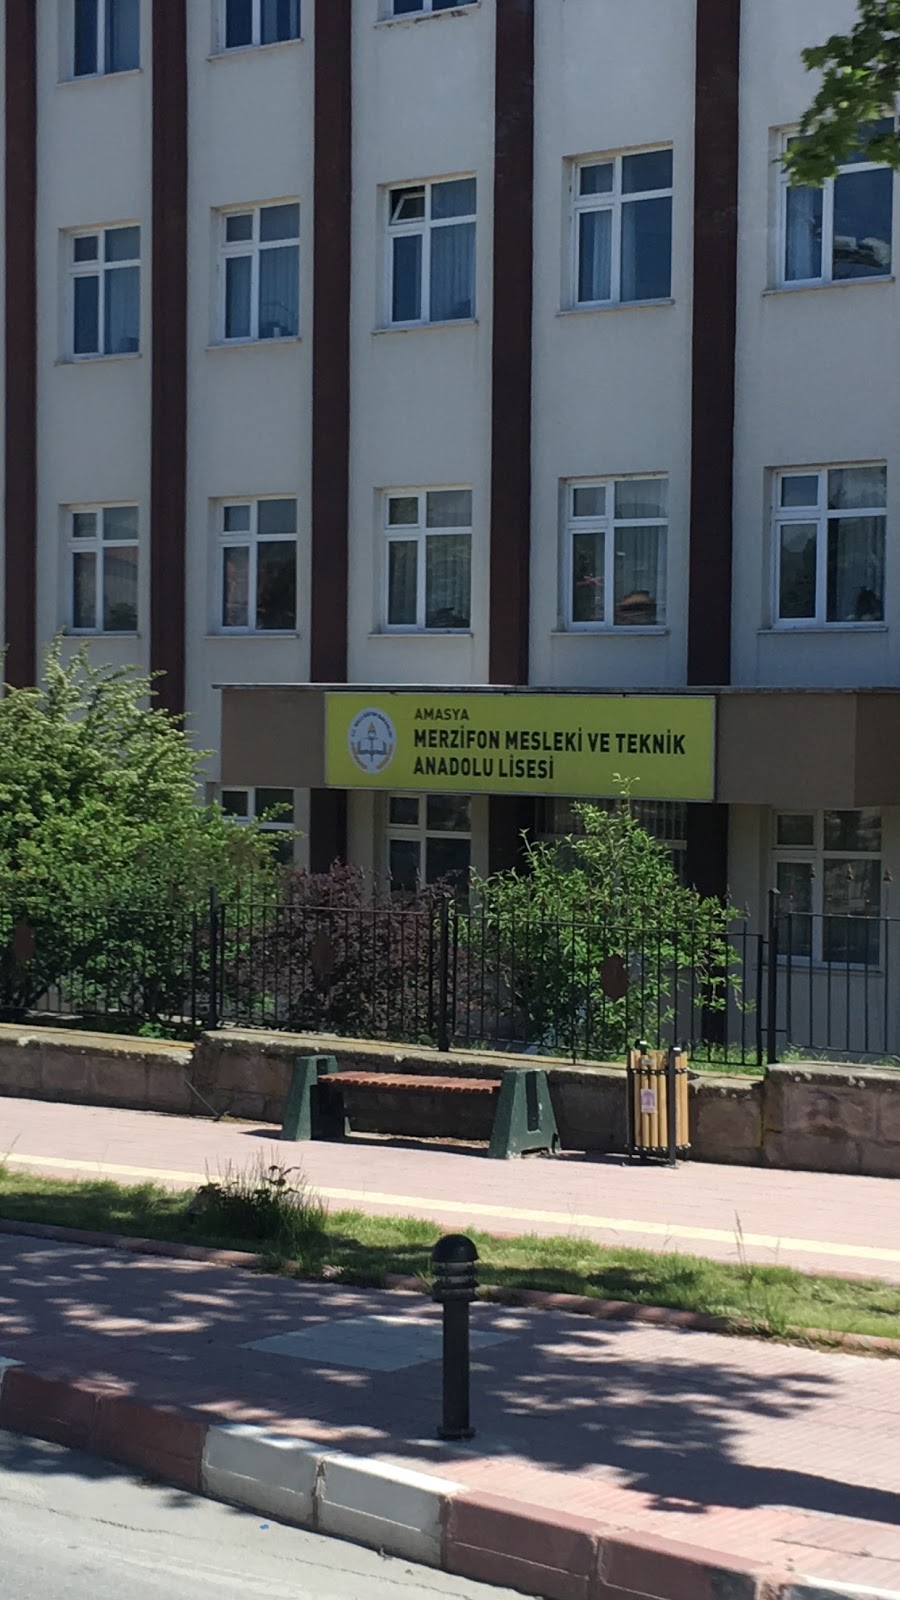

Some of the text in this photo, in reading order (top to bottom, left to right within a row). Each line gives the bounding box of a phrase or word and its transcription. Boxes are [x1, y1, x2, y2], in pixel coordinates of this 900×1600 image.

[414, 707, 469, 721] AMASYA
[413, 725, 500, 749] MERZİFON
[505, 727, 583, 752] MESLEKİ
[588, 732, 611, 753] VE
[616, 729, 686, 755] TEKNİK
[413, 754, 554, 779] ANADOLU LİSESİ
